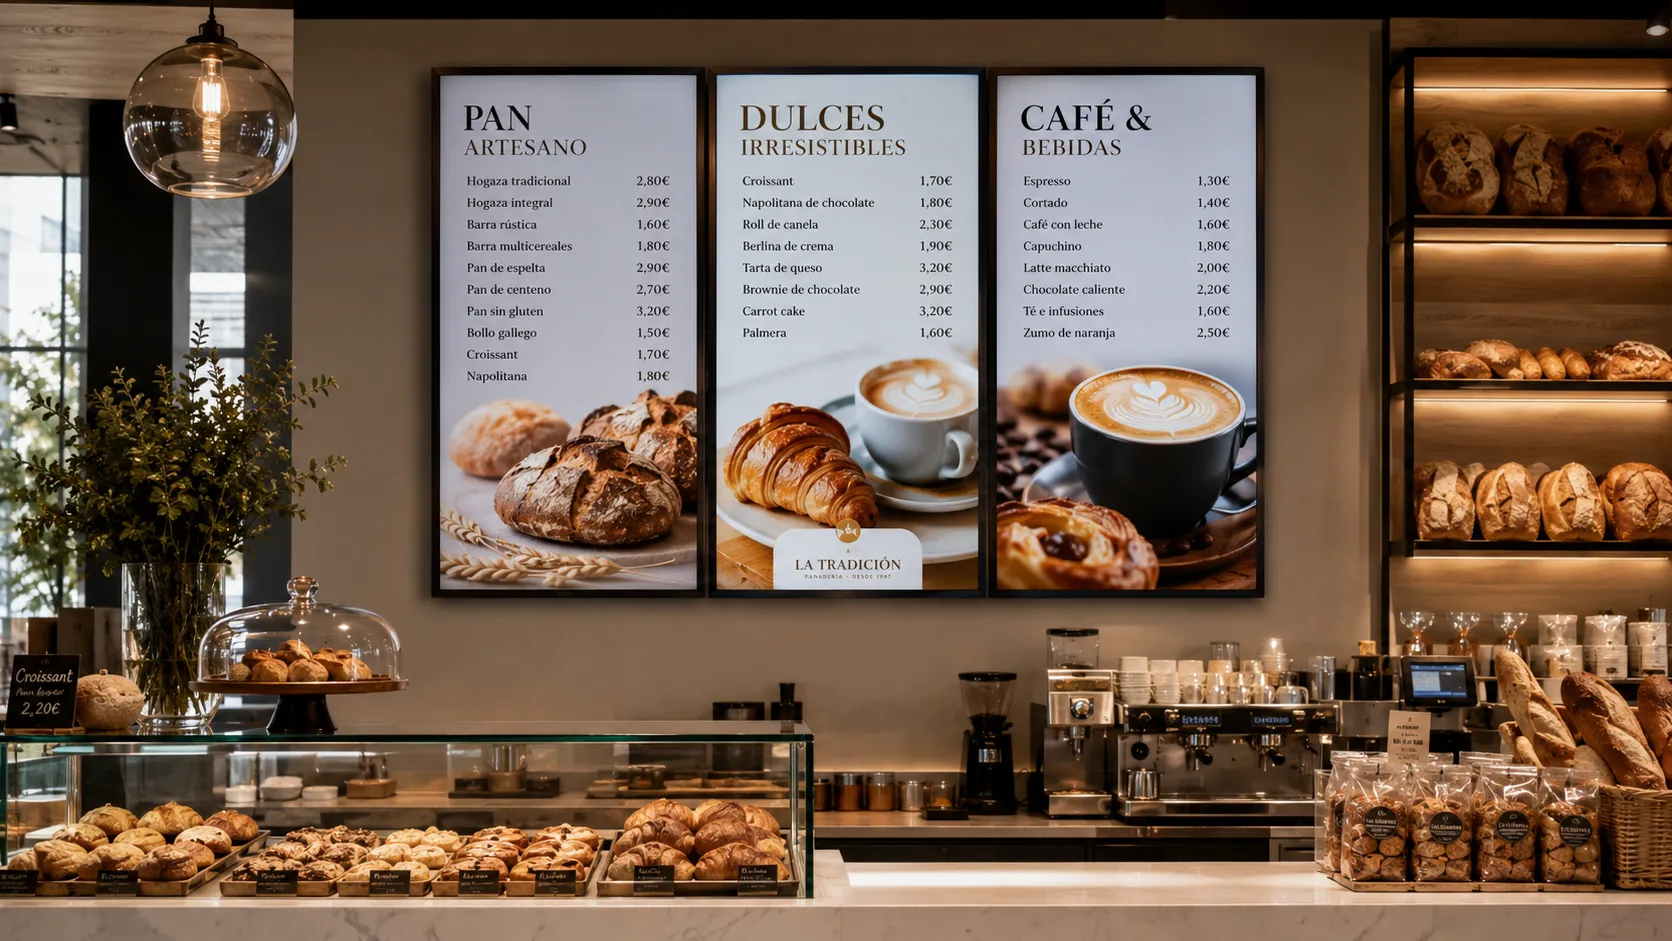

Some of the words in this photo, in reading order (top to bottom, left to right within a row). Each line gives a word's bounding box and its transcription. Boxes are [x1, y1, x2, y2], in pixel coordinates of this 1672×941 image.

[463, 104, 533, 132] PAN
[739, 104, 885, 132] DULCES
[1020, 97, 1115, 132] CAFÉ
[1125, 104, 1153, 132] &
[463, 138, 587, 156] ARTESANO
[741, 138, 906, 156] IRRESISTIBLES
[1022, 138, 1122, 156] BEBIDAS
[466, 175, 509, 189] Hogaza
[510, 175, 571, 187] tradicional
[636, 175, 671, 188] 2,80€
[742, 175, 794, 187] Croissant
[920, 175, 953, 188] 1,70€
[1023, 175, 1072, 189] Espresso
[1198, 175, 1230, 188] 1,30€
[466, 197, 509, 211] Hogaza
[510, 197, 553, 211] integral
[636, 197, 671, 210] 2,90€
[742, 197, 803, 211] Napolitana
[805, 197, 820, 209] de
[821, 197, 875, 208] chocolate
[920, 197, 953, 210] 1,80€
[1023, 197, 1069, 208] Cortado
[1197, 197, 1231, 210] 1,40€
[466, 219, 497, 230] Barra
[499, 219, 538, 230] rústica
[638, 218, 670, 232] 1,60€
[742, 218, 765, 230] Roll
[766, 218, 781, 230] de
[783, 218, 819, 230] canela
[919, 218, 953, 231] 2,30€
[1023, 218, 1049, 230] Café
[1050, 221, 1072, 230] con
[1074, 218, 1104, 230] leche
[1198, 218, 1231, 232] 1,60€
[466, 240, 497, 252] Barra
[499, 240, 573, 252] multicereales
[637, 240, 671, 253] 1,80€
[742, 240, 782, 252] Berlina
[783, 240, 798, 252] de
[799, 243, 834, 252] crema
[920, 240, 953, 253] 1,90€
[1023, 240, 1082, 254] Capuchino
[1197, 240, 1231, 253] 1,80€
[466, 262, 488, 273] Pan
[489, 262, 505, 273] de
[506, 262, 546, 276] espelta
[636, 262, 670, 275] 2,90€
[741, 262, 772, 273] Tarta
[773, 262, 788, 274] de
[789, 264, 823, 276] queso
[919, 262, 953, 275] 3,20€
[1023, 262, 1052, 274] Latte
[1054, 262, 1112, 274] macchiato
[1196, 262, 1231, 275] 2,00€
[466, 284, 488, 295] Pan
[489, 283, 505, 295] de
[506, 285, 552, 295] centeno
[636, 284, 671, 297] 2,70€
[742, 283, 789, 295] Brownie
[790, 283, 805, 295] de
[807, 283, 861, 295] chocolate
[919, 283, 953, 297] 2,90€
[1023, 283, 1080, 295] Chocolate
[1081, 283, 1126, 295] caliente
[1196, 284, 1231, 297] 2,20€
[466, 305, 488, 317] Pan
[489, 305, 507, 317] sin
[508, 305, 544, 320] gluten
[636, 305, 671, 318] 3,20€
[742, 305, 778, 317] Carrot
[780, 305, 806, 317] cake
[919, 305, 953, 318] 3,20€
[1022, 305, 1037, 317] Té
[1038, 308, 1046, 317] e
[1048, 305, 1105, 317] infusiones
[1197, 305, 1231, 318] 1,60€
[467, 327, 496, 339] Bollo
[497, 327, 538, 341] gallego
[637, 327, 670, 340] 1,50€
[742, 327, 787, 339] Palmera
[920, 327, 953, 340] 1,60€
[1022, 327, 1056, 339] Zumo
[1057, 327, 1072, 339] de
[1074, 327, 1116, 341] naranja
[1196, 327, 1231, 340] 2,50€
[466, 349, 519, 360] Croissant
[637, 349, 671, 362] 1,70€
[466, 370, 528, 384] Napolitana
[637, 370, 671, 383] 1,80€
[795, 559, 814, 571] LA
[817, 556, 901, 571] TRADICIÓN
[15, 667, 74, 683] Croissant
[20, 701, 61, 717] 2,20€
